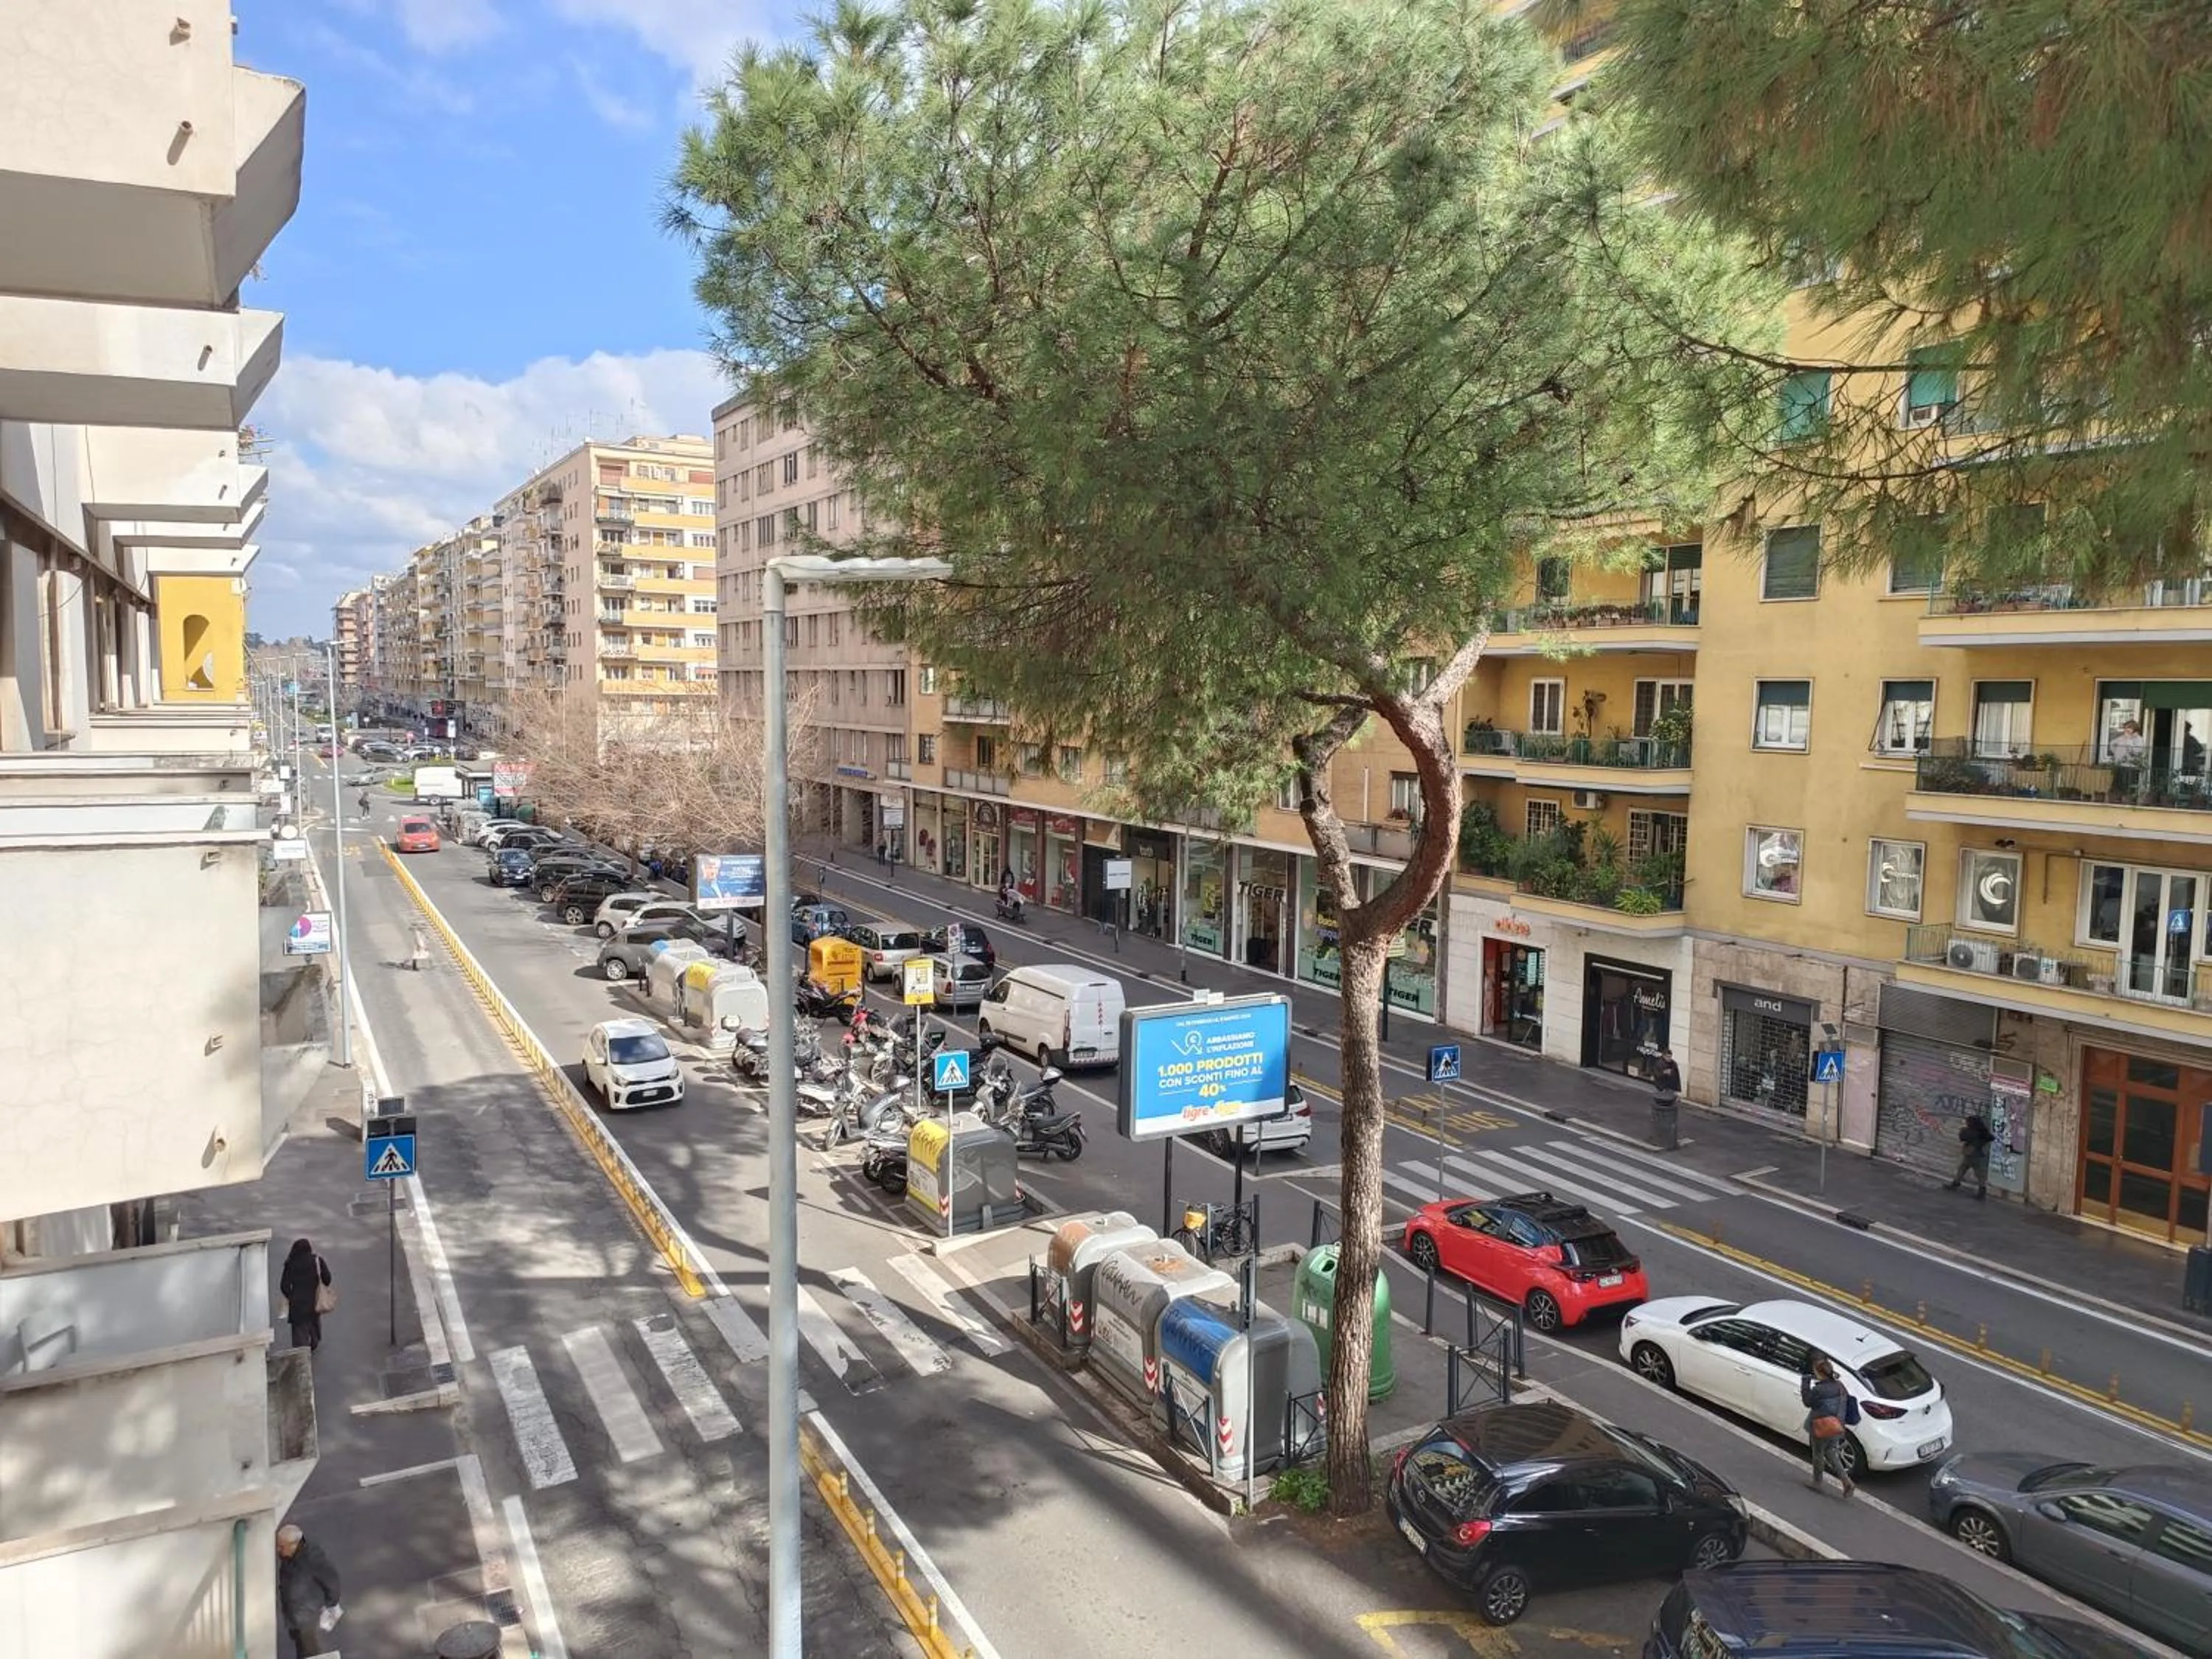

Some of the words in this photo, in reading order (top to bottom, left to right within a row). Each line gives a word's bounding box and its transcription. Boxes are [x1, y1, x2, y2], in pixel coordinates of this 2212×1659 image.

[1238, 881, 1284, 902] TIGER
[1190, 933, 1213, 946] TIGER
[1388, 987, 1419, 1004] TIGER
[1754, 998, 1781, 1012] and
[1158, 1062, 1193, 1077] 1.000
[1197, 1053, 1263, 1071] PRODOTTI
[1158, 1076, 1182, 1088] CON
[1185, 1071, 1222, 1085] SCONTI
[1225, 1067, 1248, 1079] FINO
[1250, 1065, 1263, 1075] AL
